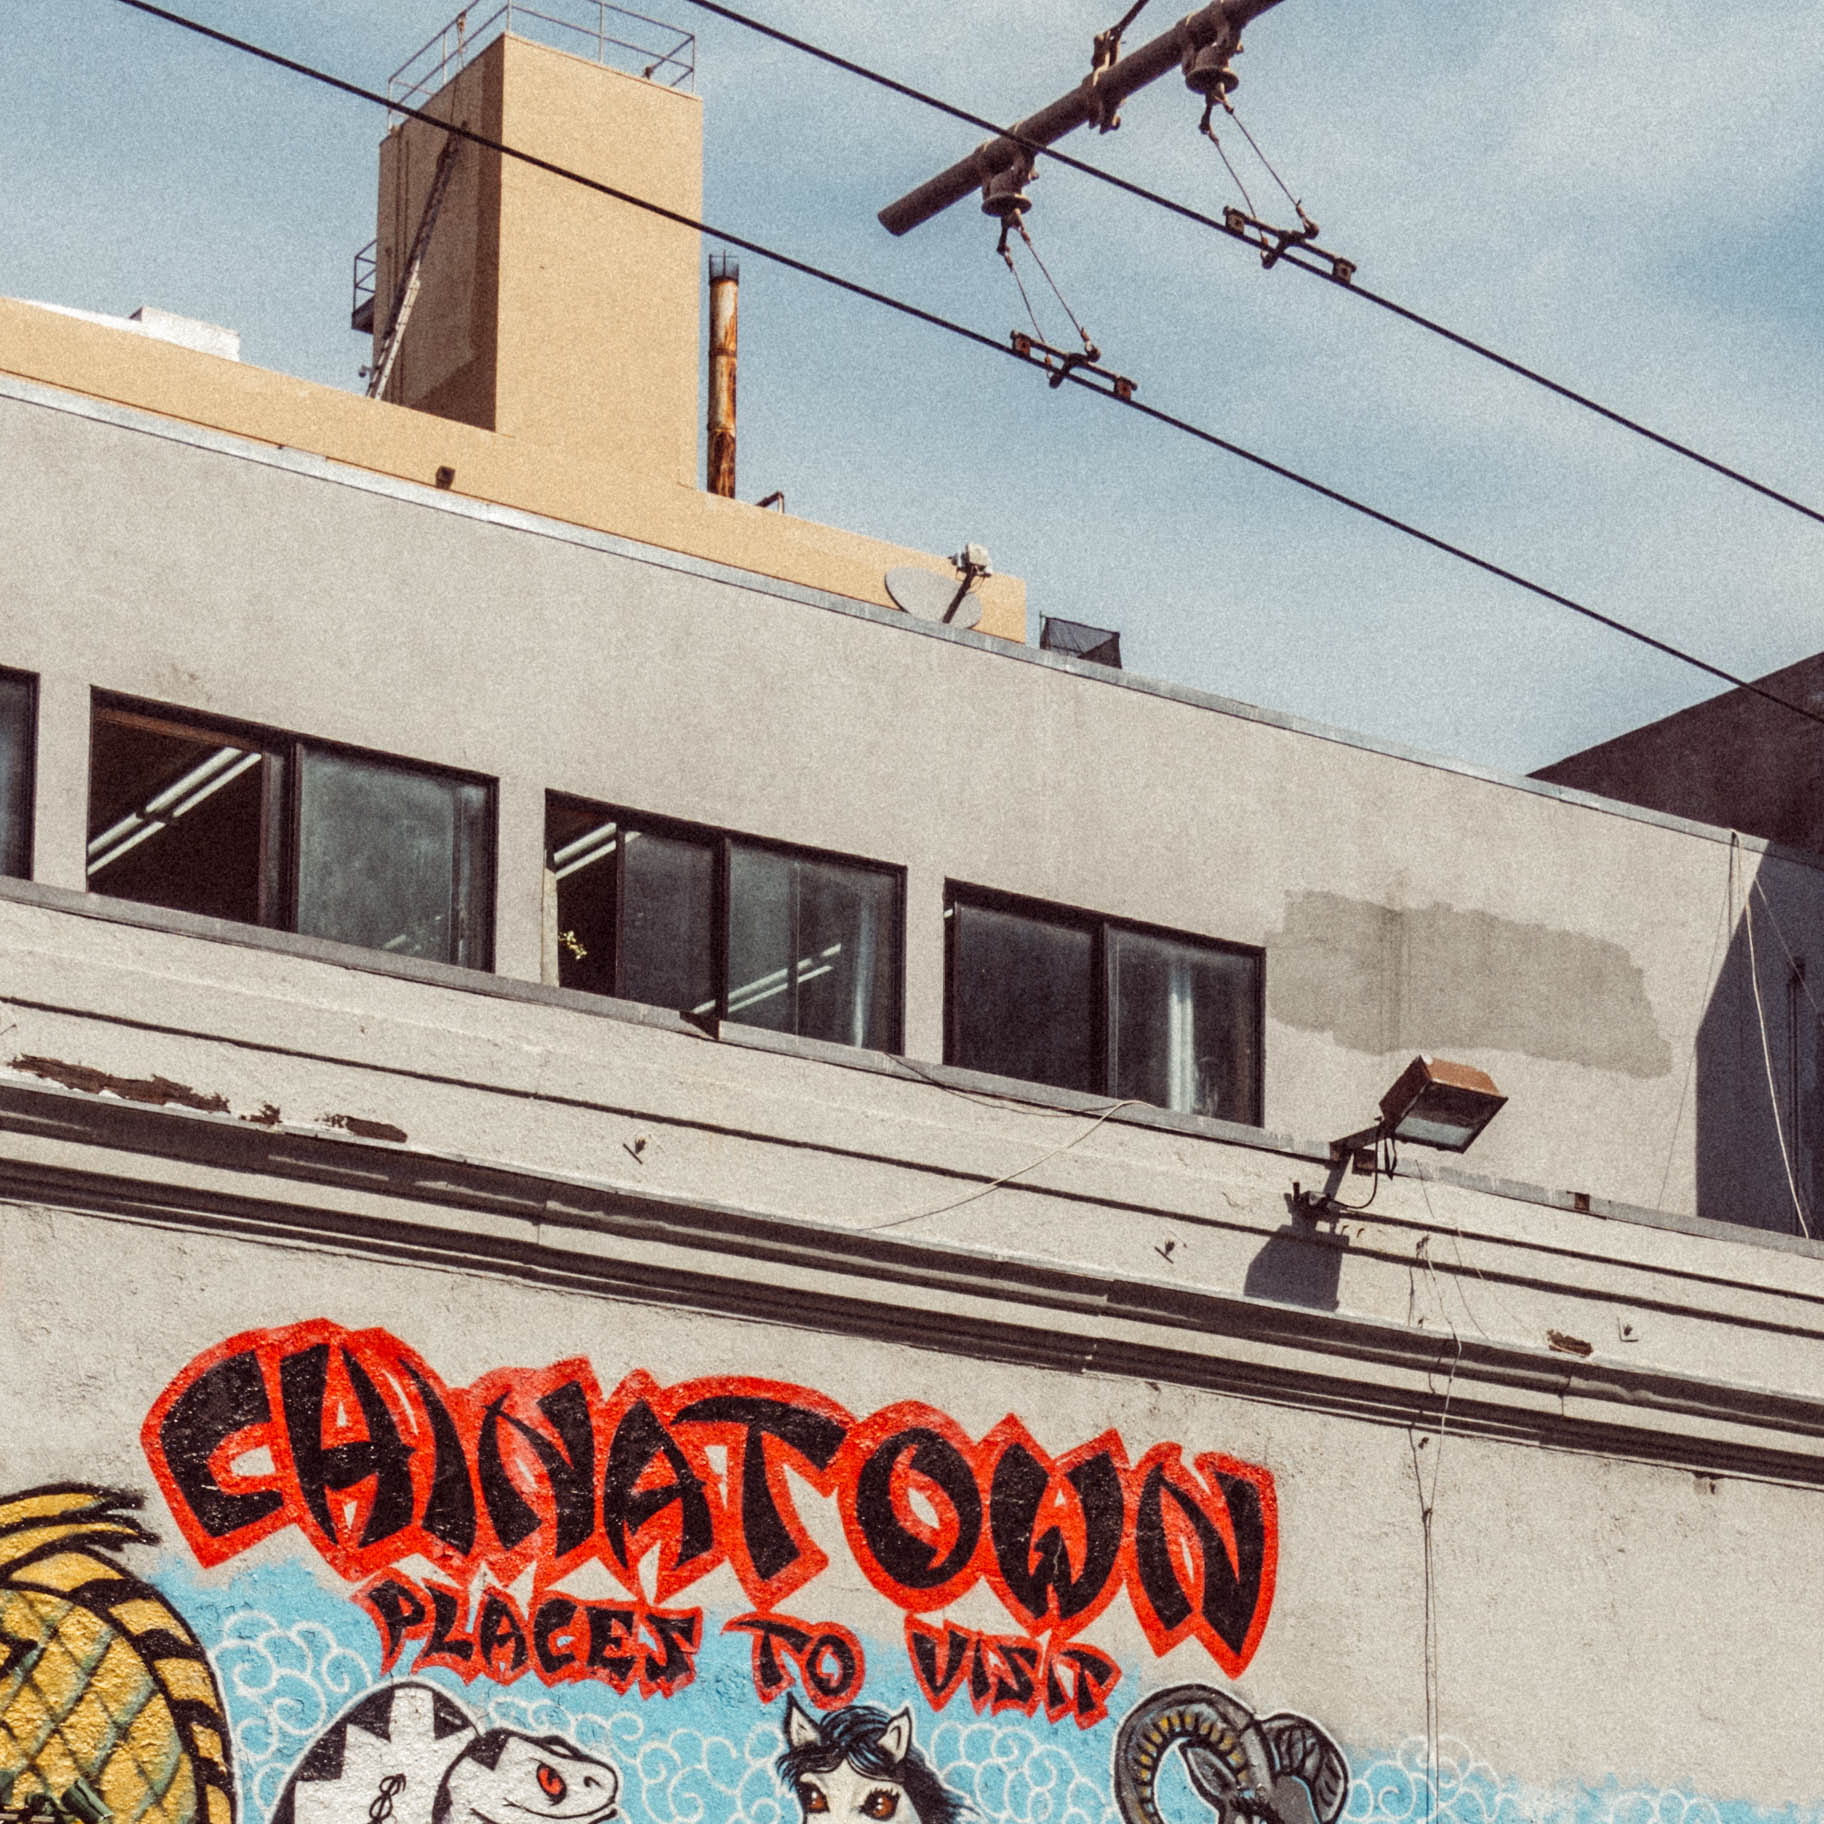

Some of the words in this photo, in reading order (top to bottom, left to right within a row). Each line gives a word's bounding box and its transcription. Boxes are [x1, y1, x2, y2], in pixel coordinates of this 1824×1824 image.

[144, 1320, 1277, 1680] CHINATOWN
[356, 1578, 703, 1698] PLACES
[722, 1610, 865, 1708] TO
[904, 1612, 1122, 1723] VISIT
